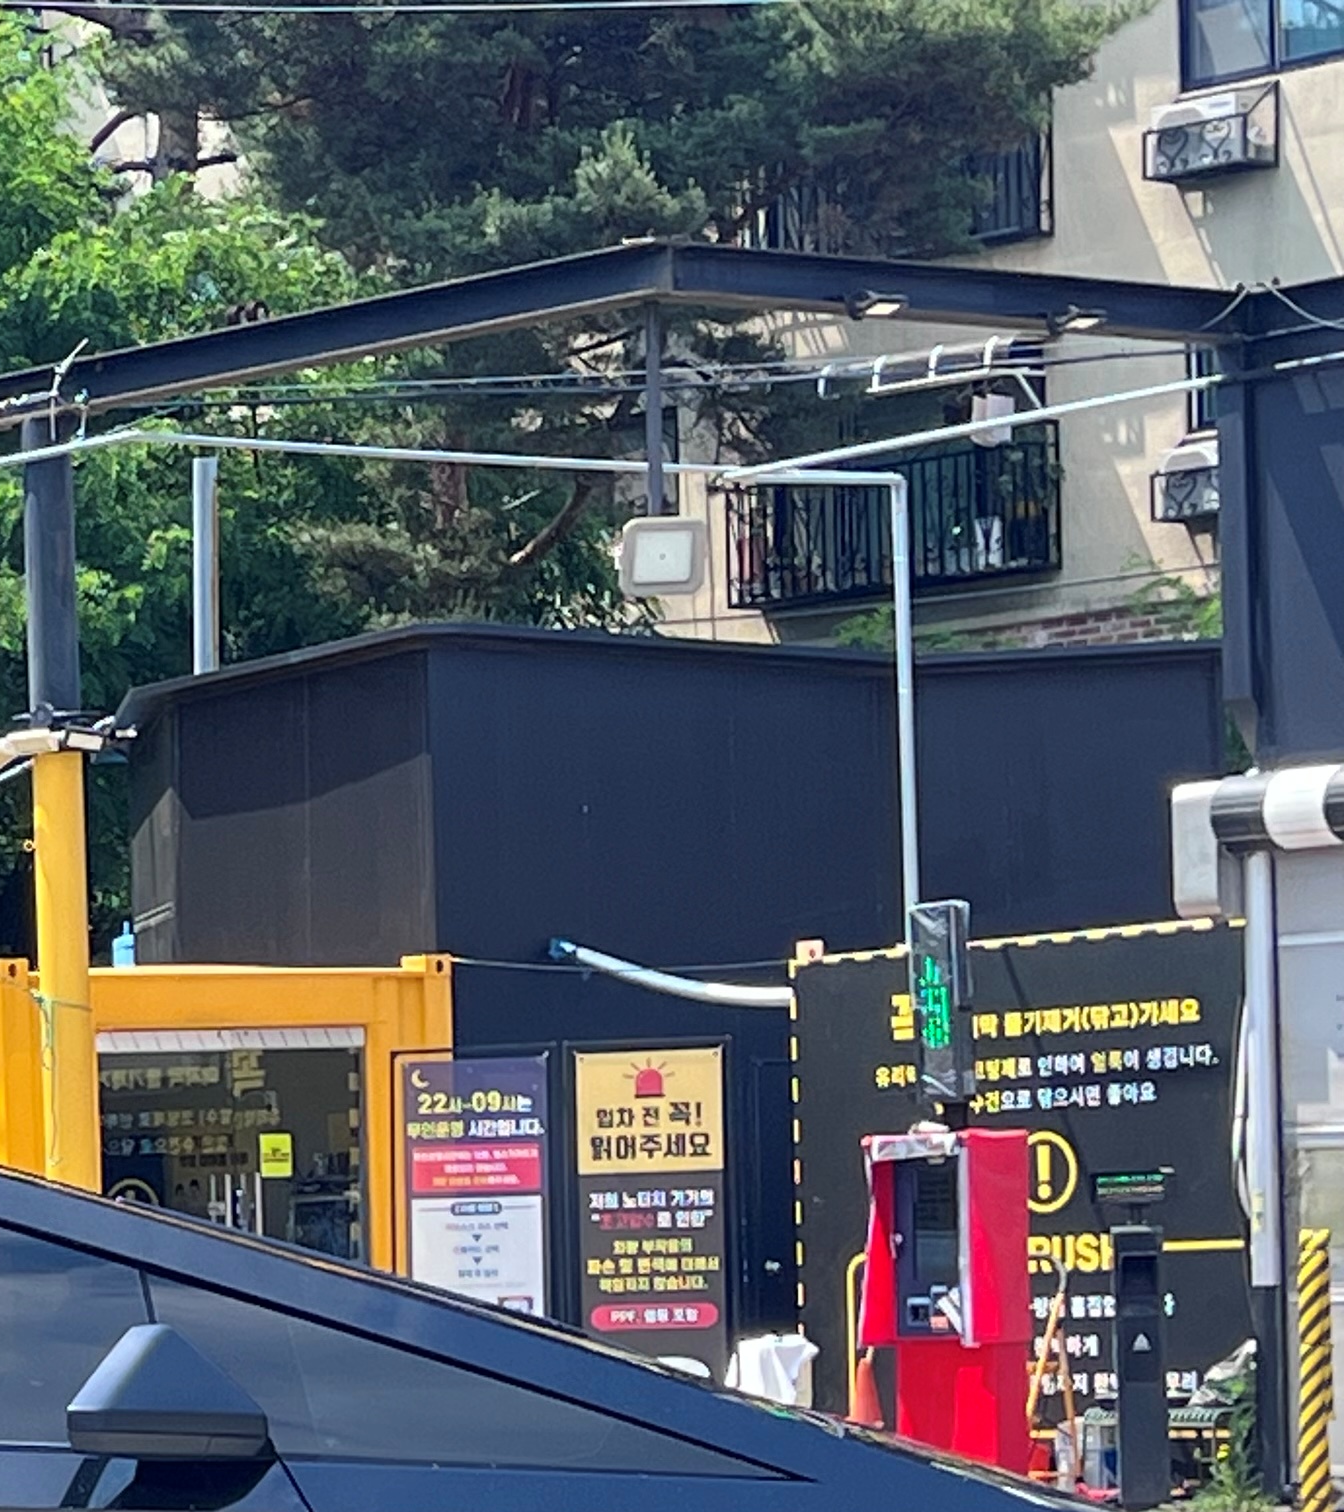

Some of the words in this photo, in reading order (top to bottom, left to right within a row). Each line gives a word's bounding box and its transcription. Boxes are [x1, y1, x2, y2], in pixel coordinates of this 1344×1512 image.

[596, 1107, 635, 1129] 입차
[642, 1106, 660, 1128] 전
[590, 1133, 713, 1161] 읽어주세요
